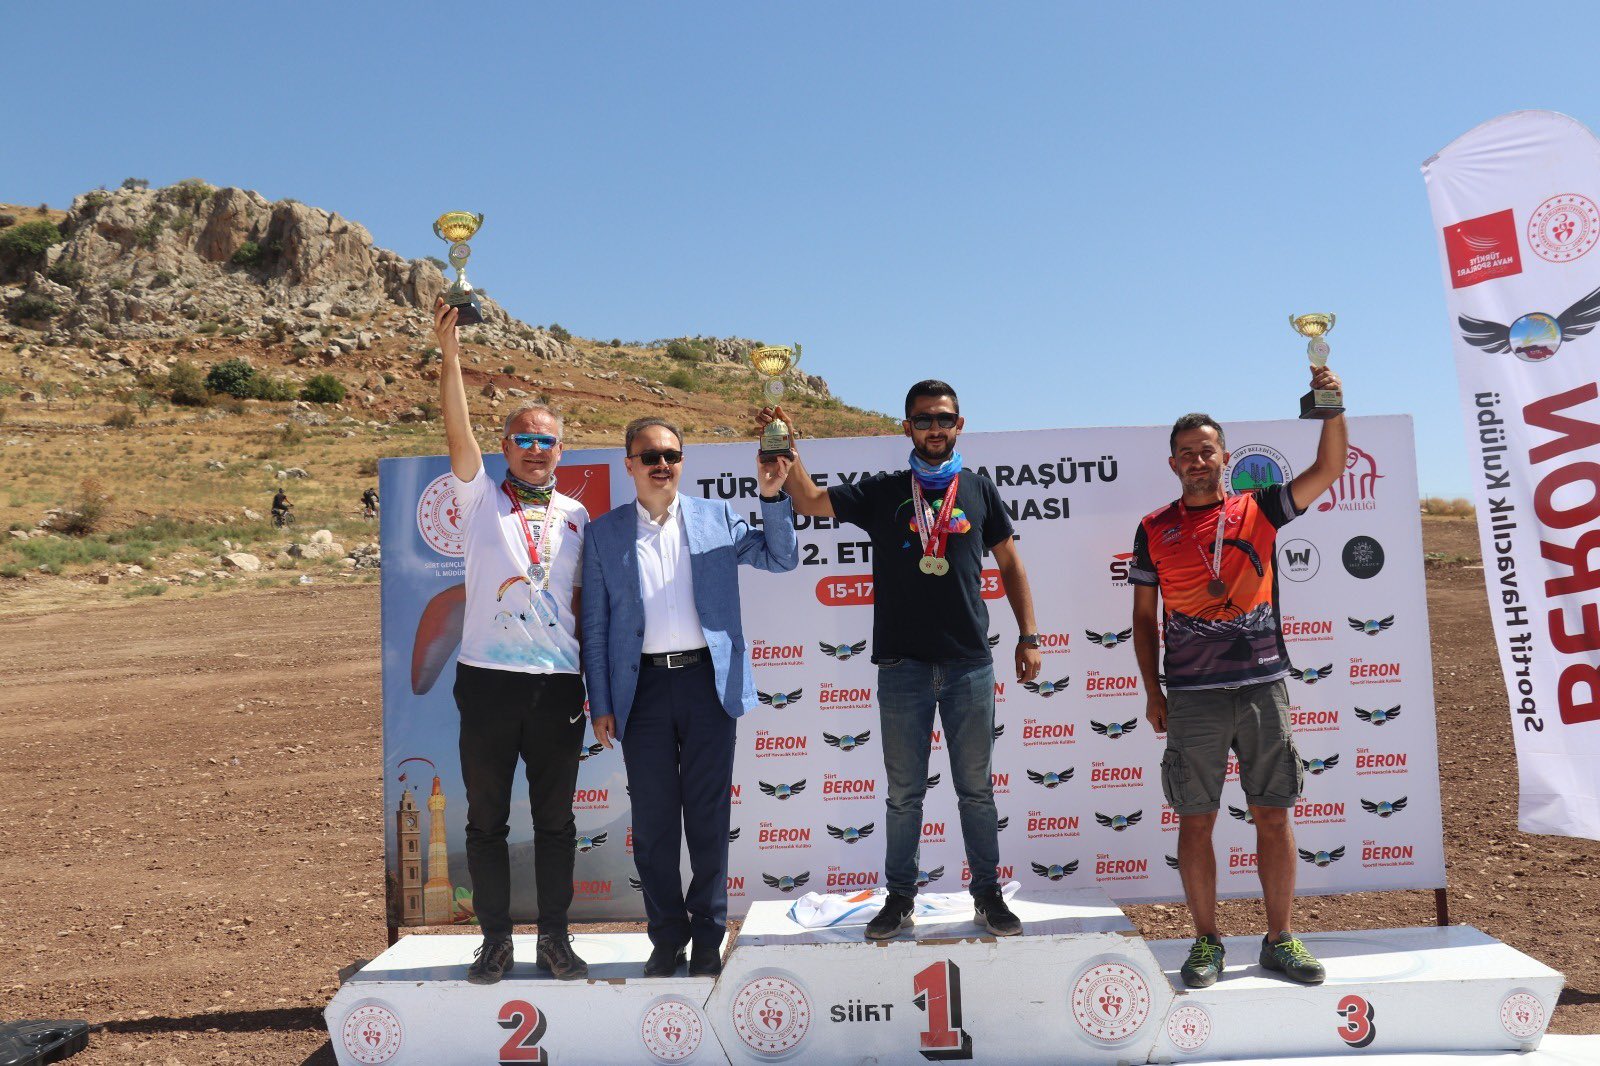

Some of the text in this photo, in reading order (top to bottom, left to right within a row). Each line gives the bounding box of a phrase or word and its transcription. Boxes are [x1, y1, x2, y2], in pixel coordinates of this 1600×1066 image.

[1338, 501, 1376, 512] VALİLİĞİ
[803, 544, 827, 565] 2.
[828, 583, 873, 599] 15-17
[1282, 621, 1332, 635] BERON
[1039, 634, 1069, 647] RON
[752, 646, 803, 659] BERON
[1350, 662, 1400, 678] BERON
[1086, 675, 1137, 691] BERON
[820, 687, 871, 703] BERON
[1023, 723, 1074, 739] BERON
[756, 736, 806, 750] BERON
[1356, 754, 1406, 768] BERON
[1091, 767, 1142, 782] BERON
[823, 780, 874, 794] BERON
[573, 789, 608, 802] RON
[1294, 803, 1344, 818] BERON
[1028, 815, 1078, 831] BERON
[759, 829, 810, 842] BERON
[1230, 854, 1259, 867] BER
[1362, 846, 1412, 860] BERON
[1096, 858, 1147, 874] BERON
[827, 872, 878, 886] BERON
[912, 959, 969, 1058] 1
[1337, 994, 1374, 1047] 3
[498, 1000, 547, 1066] 2
